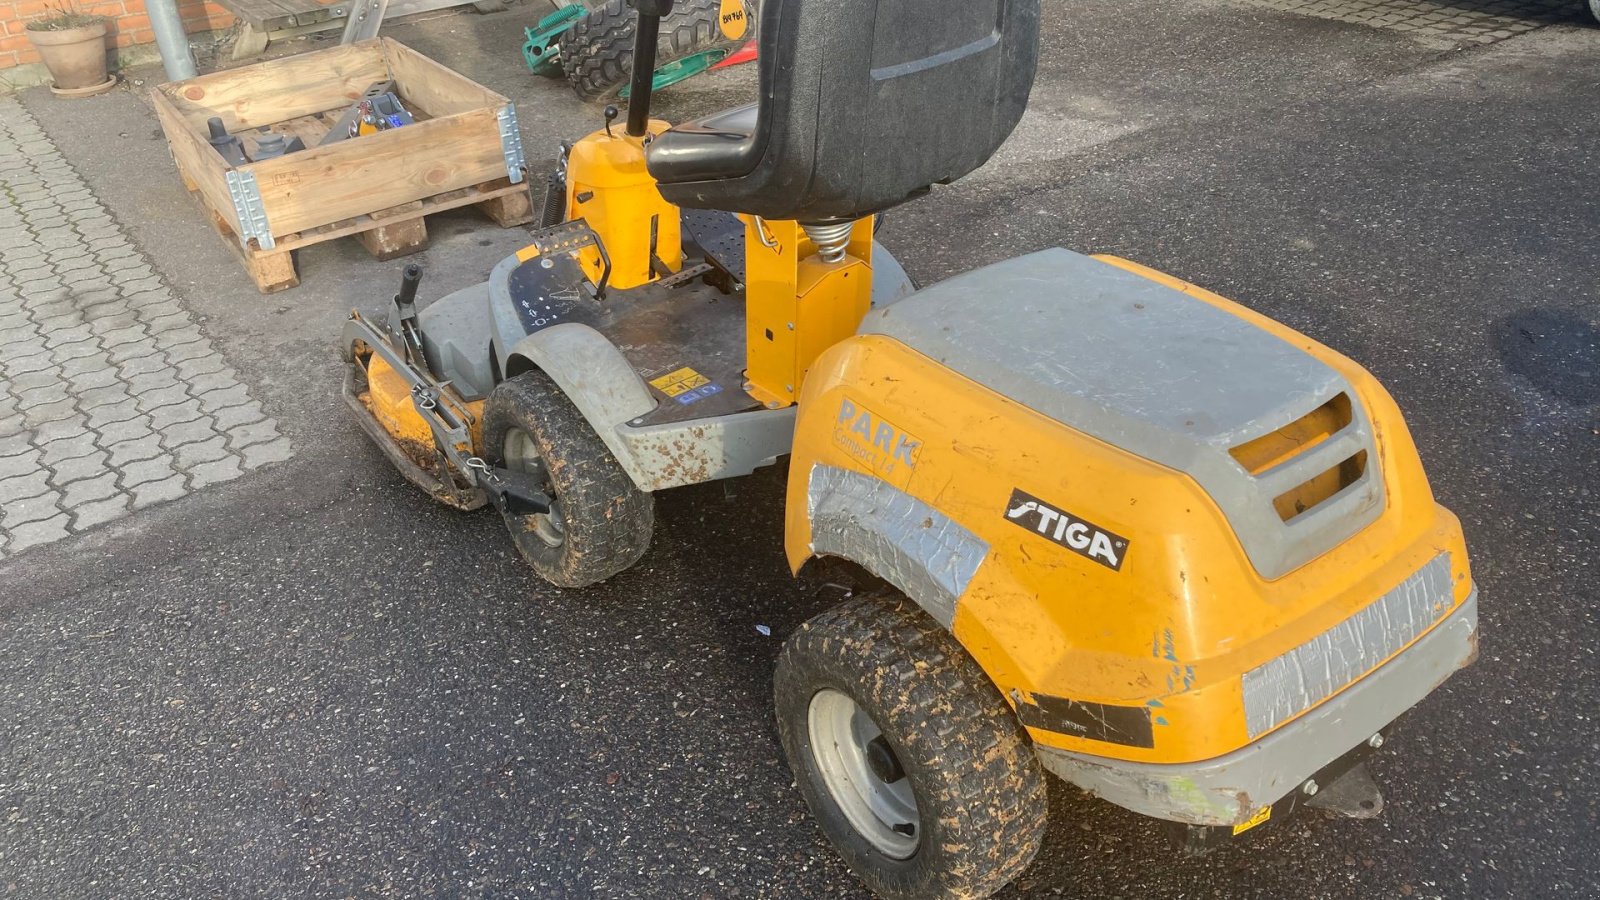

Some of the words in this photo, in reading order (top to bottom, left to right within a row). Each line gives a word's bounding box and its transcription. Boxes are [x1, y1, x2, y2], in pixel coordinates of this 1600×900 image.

[833, 428, 877, 465] Compact
[837, 399, 920, 468] PARK
[1008, 501, 1119, 567] STIGA
